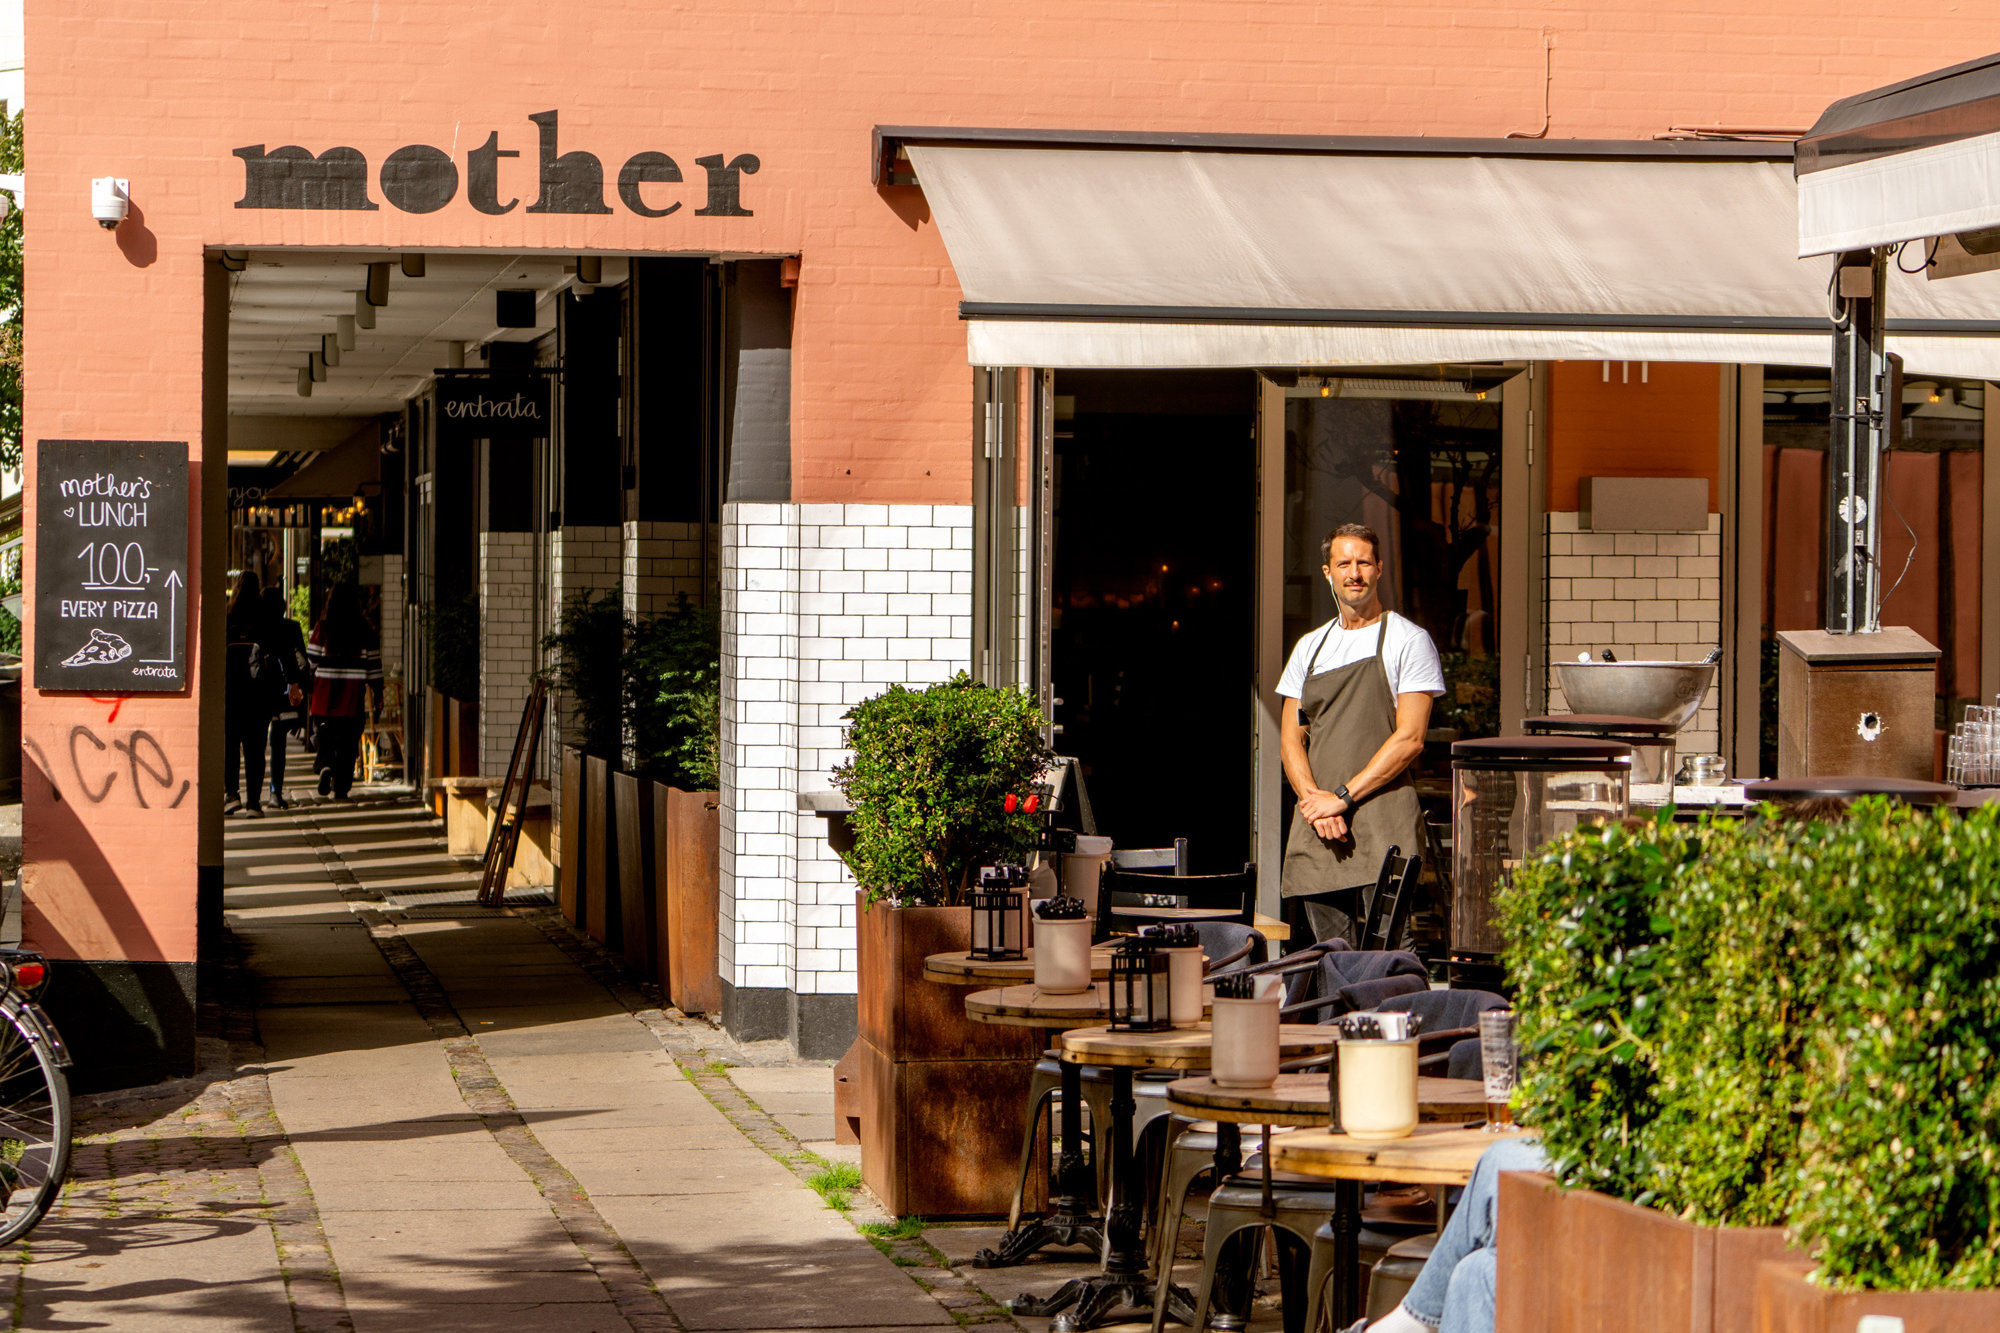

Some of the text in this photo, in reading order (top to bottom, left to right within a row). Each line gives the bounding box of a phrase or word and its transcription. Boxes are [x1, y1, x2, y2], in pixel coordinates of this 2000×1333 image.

[232, 109, 761, 218] mother
[444, 392, 541, 419] entrata
[60, 473, 153, 499] mother's
[78, 501, 148, 528] LUNCH
[60, 600, 107, 618] EVERY
[131, 666, 178, 678] entrata
